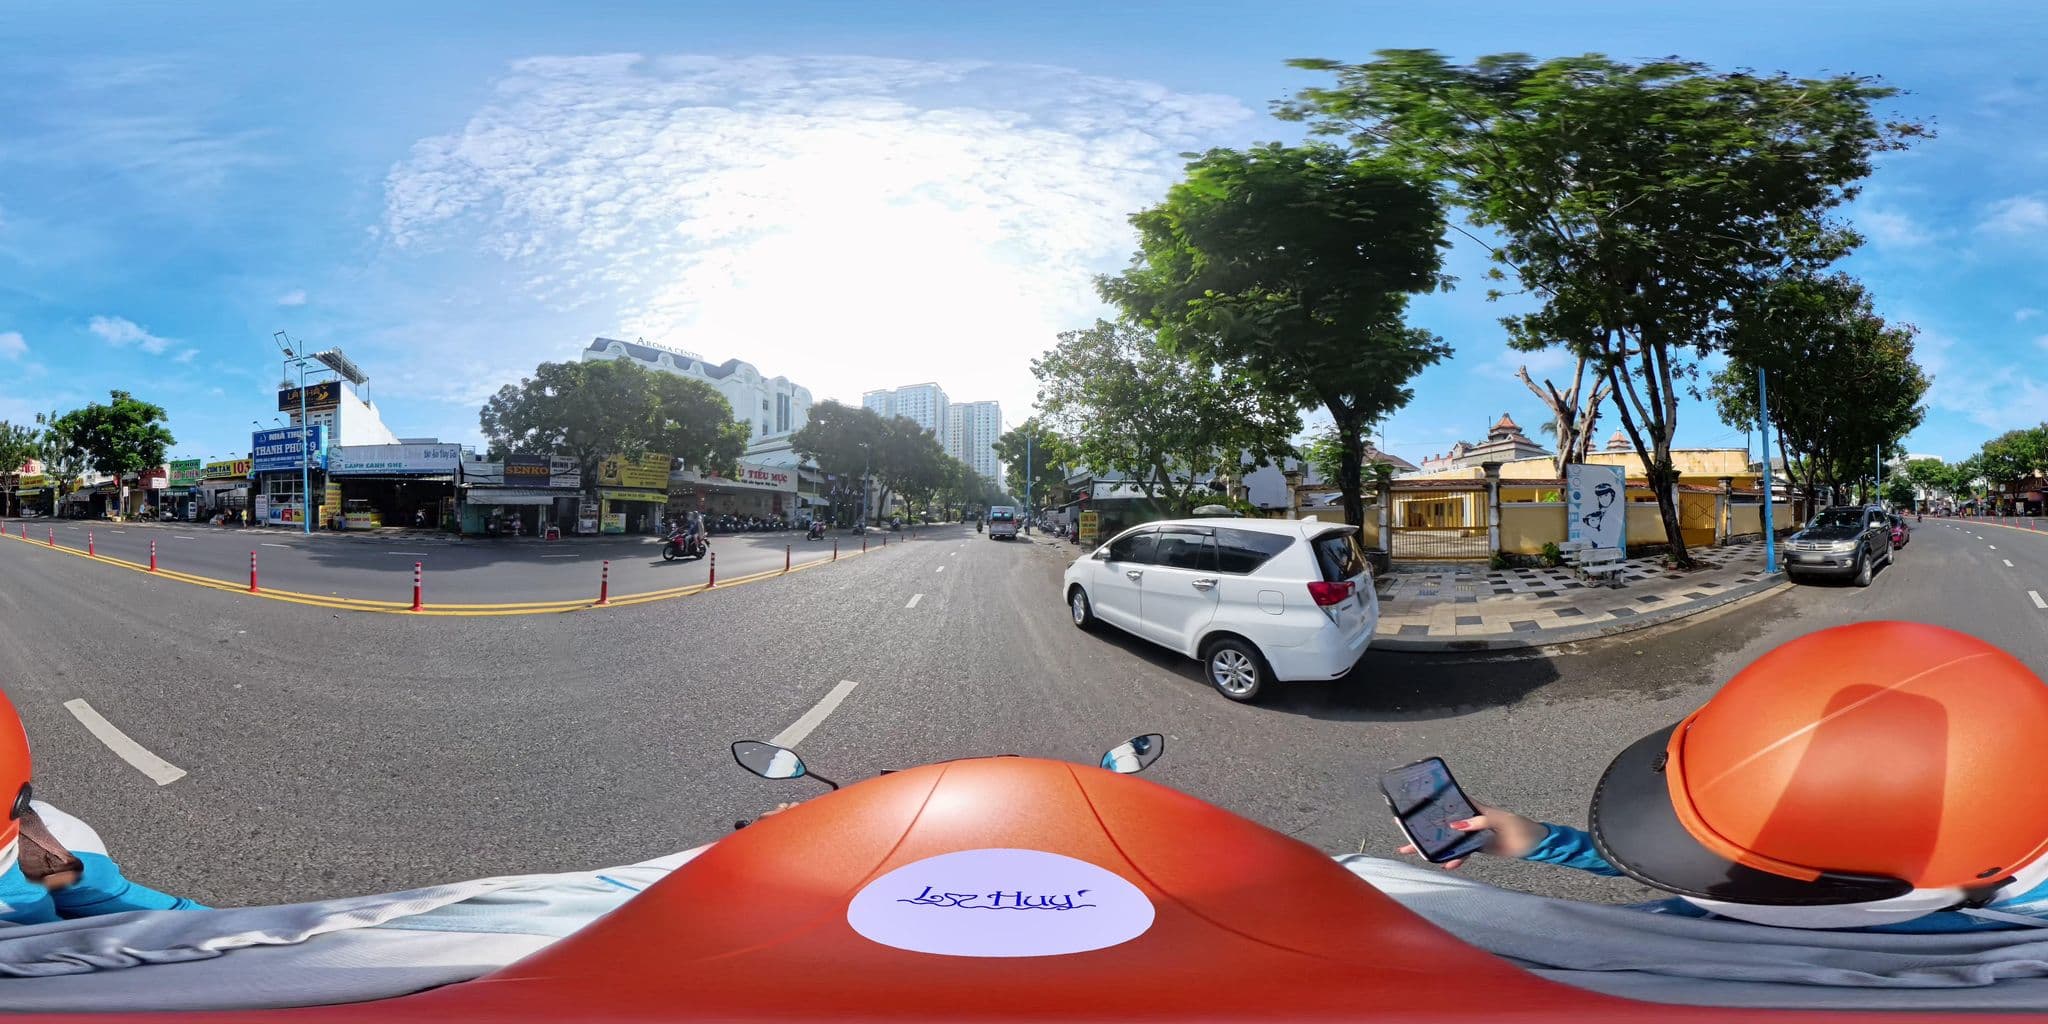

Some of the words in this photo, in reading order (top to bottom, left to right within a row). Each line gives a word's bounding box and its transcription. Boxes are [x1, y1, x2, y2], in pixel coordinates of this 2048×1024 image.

[285, 429, 314, 440] THUC
[255, 444, 283, 456] THANH
[284, 440, 308, 454] PHÚ
[309, 441, 317, 451] 9
[233, 460, 251, 474] 103
[505, 465, 549, 475] SENKO
